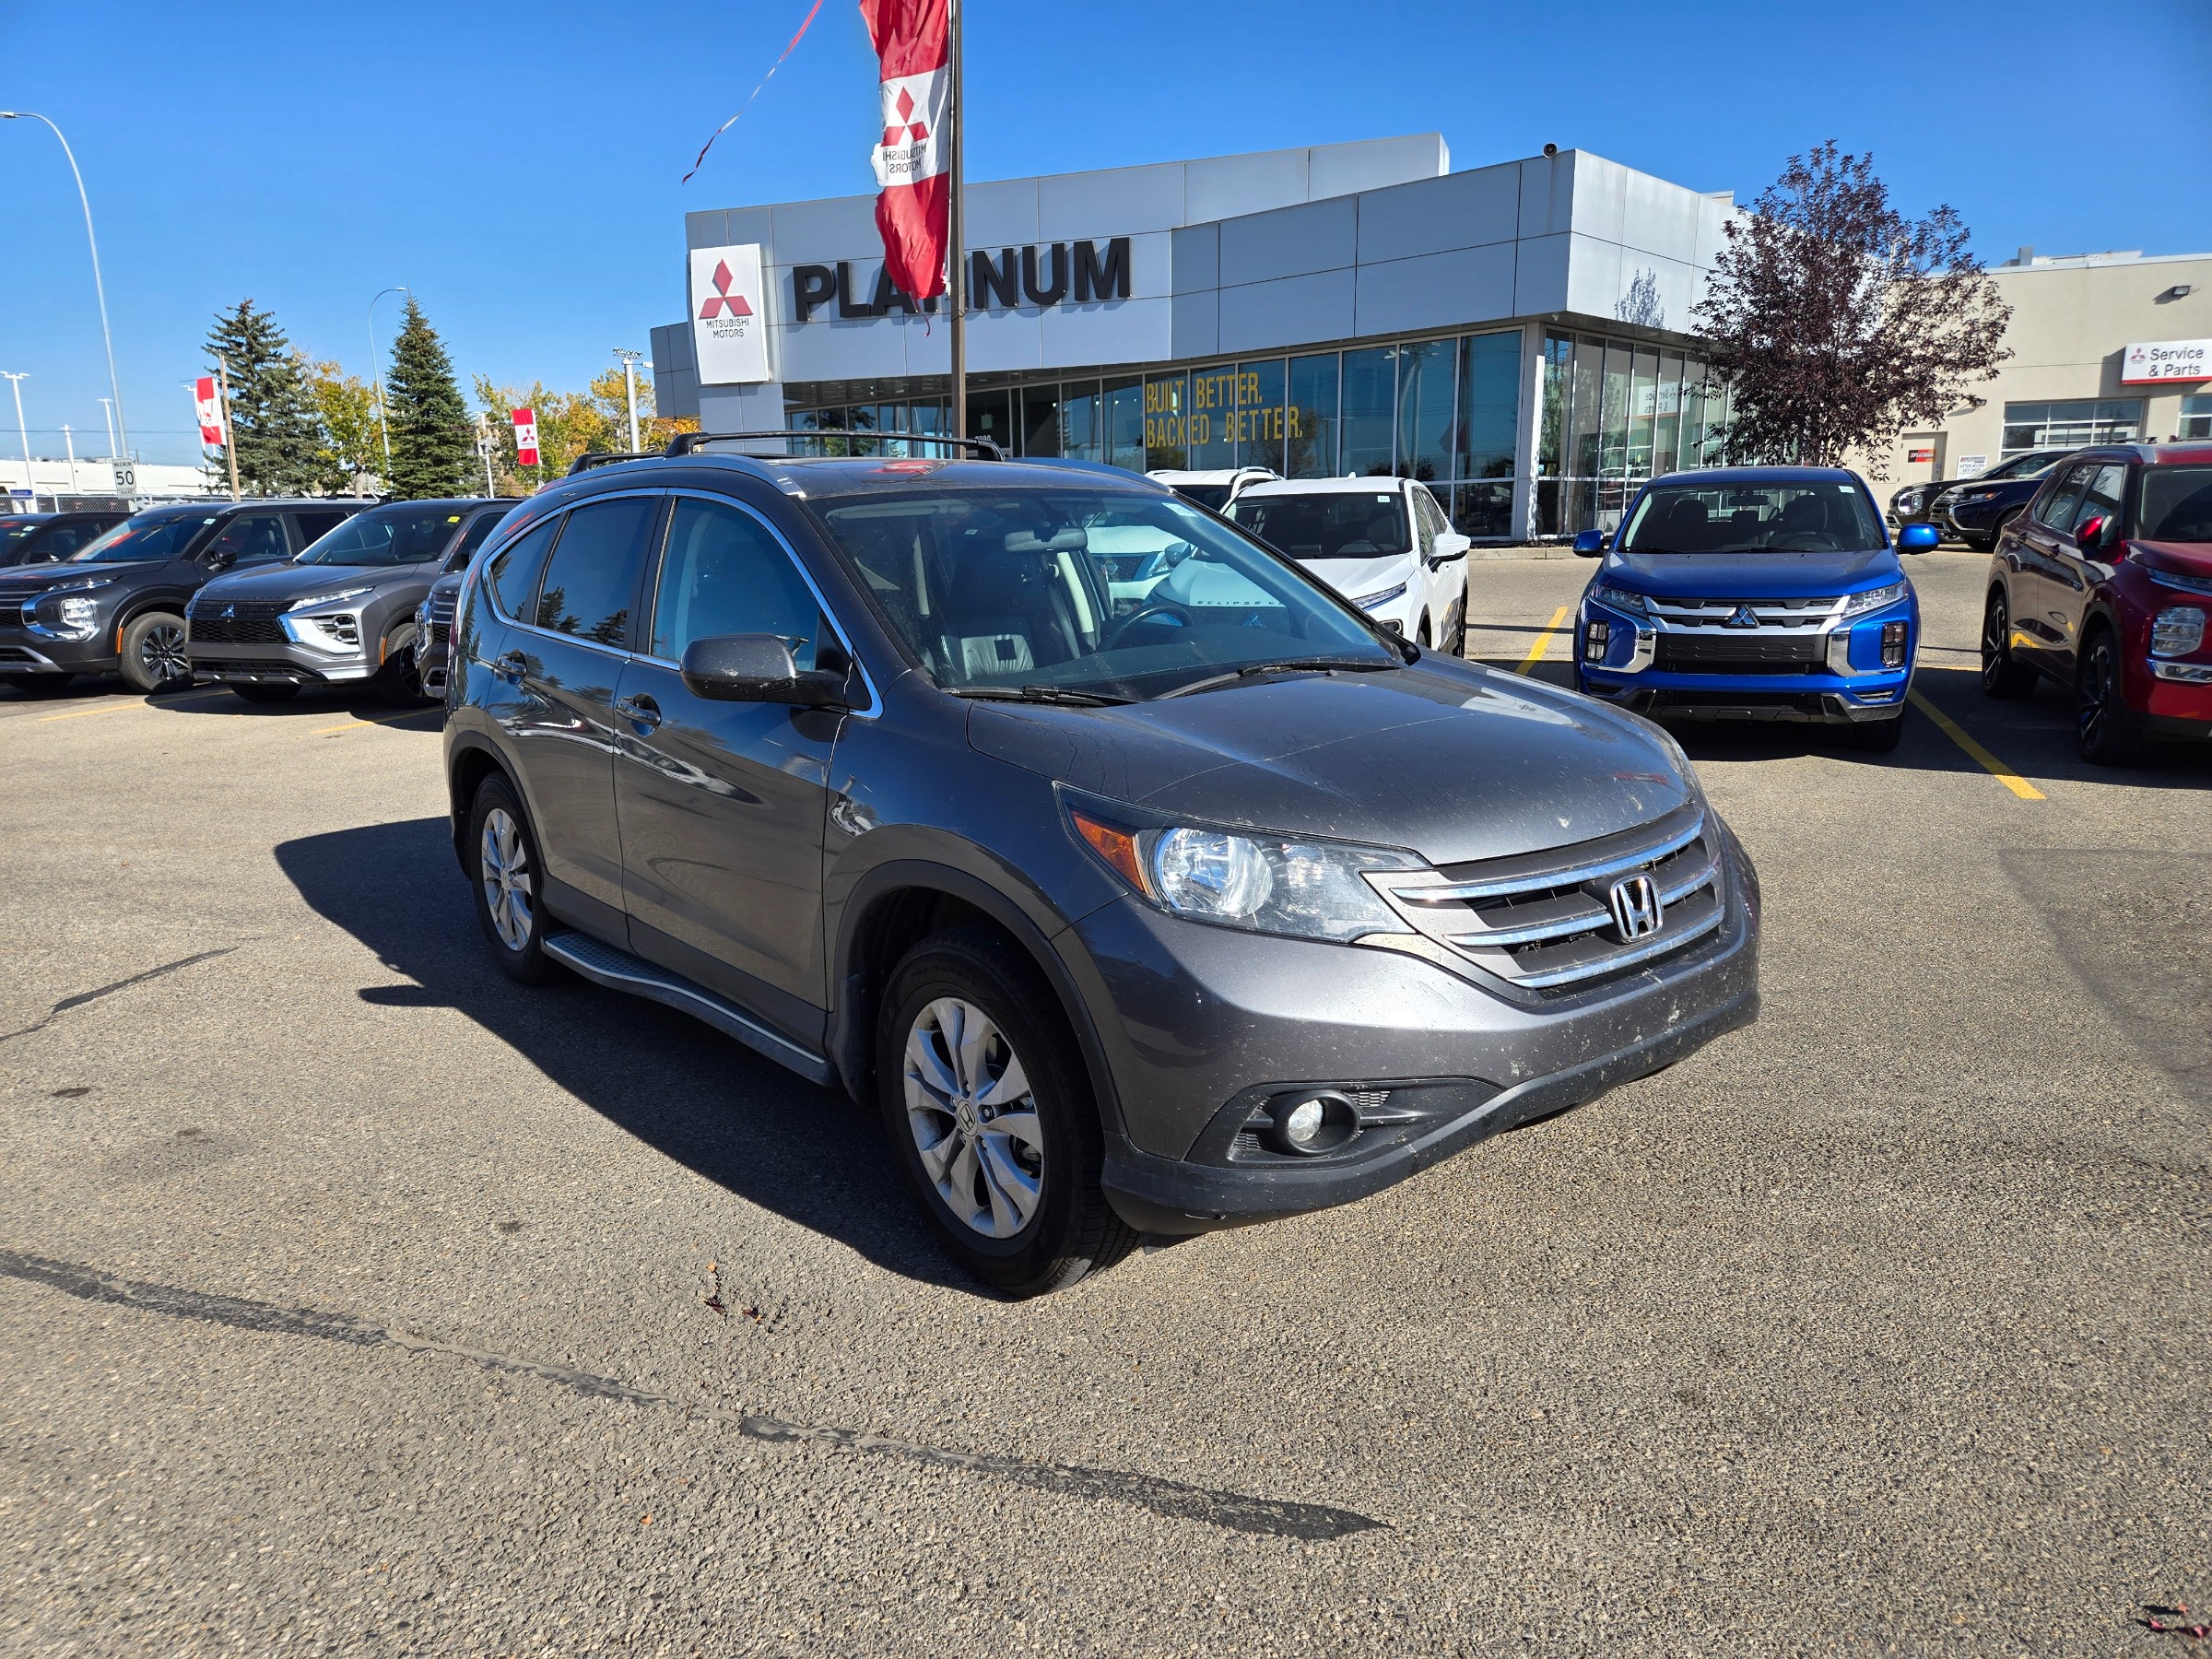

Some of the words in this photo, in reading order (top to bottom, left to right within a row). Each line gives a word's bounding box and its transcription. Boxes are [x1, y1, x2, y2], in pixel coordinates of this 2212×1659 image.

[793, 237, 1131, 322] PLANUM
[706, 318, 749, 329] MITSUBISHI
[712, 328, 745, 339] MOTORS
[2149, 347, 2204, 361] Service
[2148, 364, 2159, 377] &
[2164, 363, 2201, 377] Parts
[1146, 380, 1184, 414] BUILT
[1195, 371, 1263, 409] BETTER.
[1146, 414, 1210, 449] BACKED
[1225, 406, 1303, 443] BETTER.
[115, 470, 135, 486] 50
